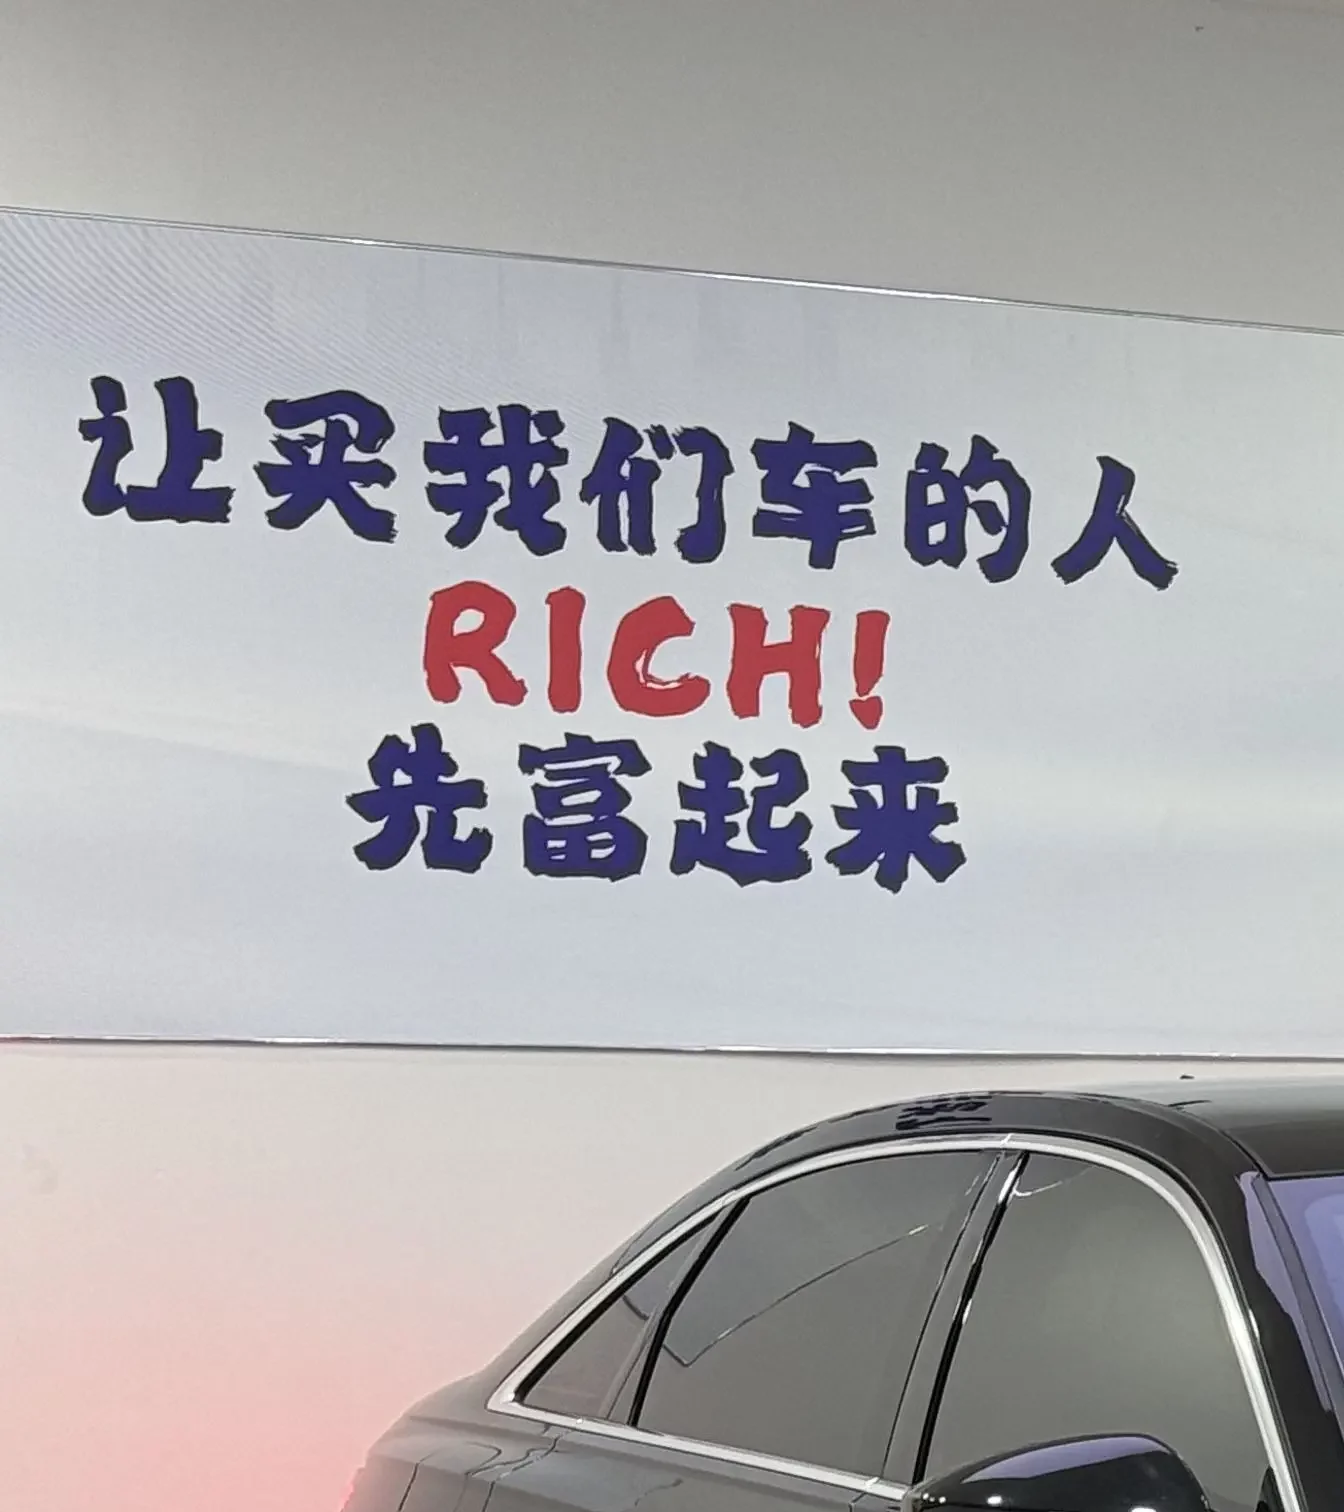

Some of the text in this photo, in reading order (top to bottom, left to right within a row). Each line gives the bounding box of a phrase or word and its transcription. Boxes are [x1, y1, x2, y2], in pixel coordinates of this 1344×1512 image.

[79, 376, 1178, 590] 让买我们车的人
[424, 581, 890, 731] RICH!
[346, 723, 966, 893] 先富起来
